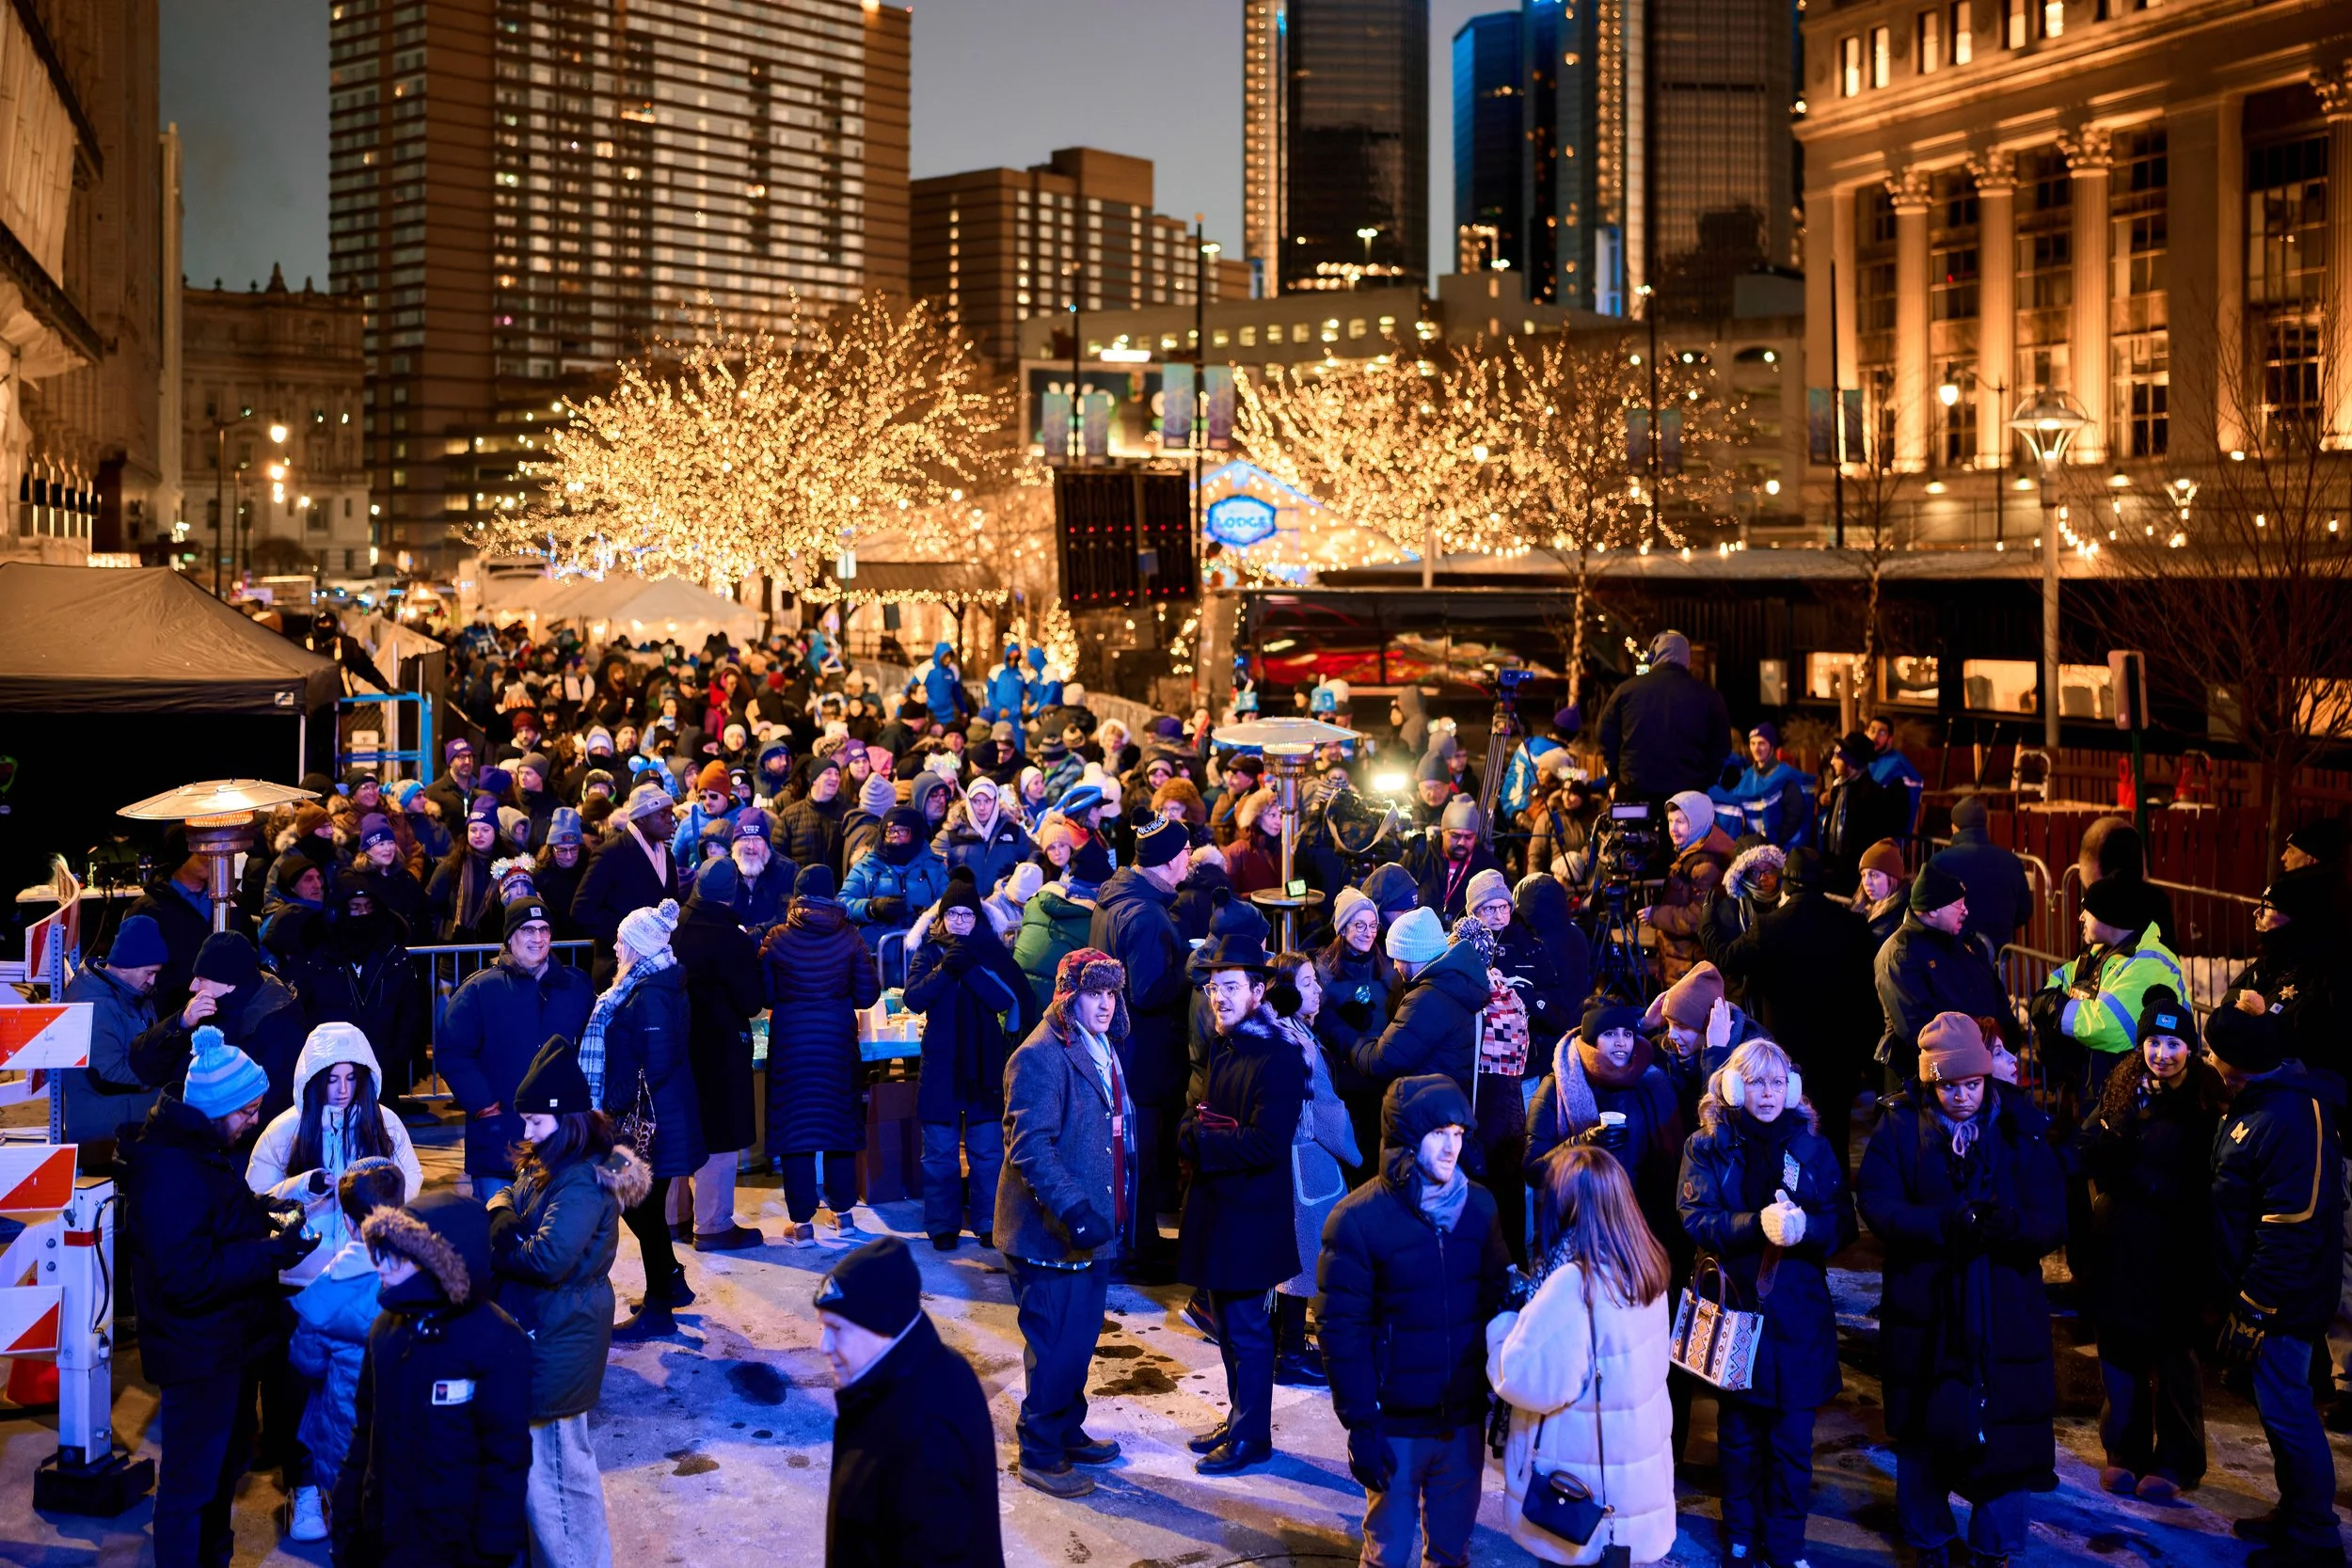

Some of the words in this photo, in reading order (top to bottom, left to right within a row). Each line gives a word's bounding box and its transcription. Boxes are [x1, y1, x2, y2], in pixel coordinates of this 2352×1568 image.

[1215, 515, 1267, 529] LODGE
[2230, 1121, 2249, 1145] M
[2237, 1321, 2257, 1338] M
